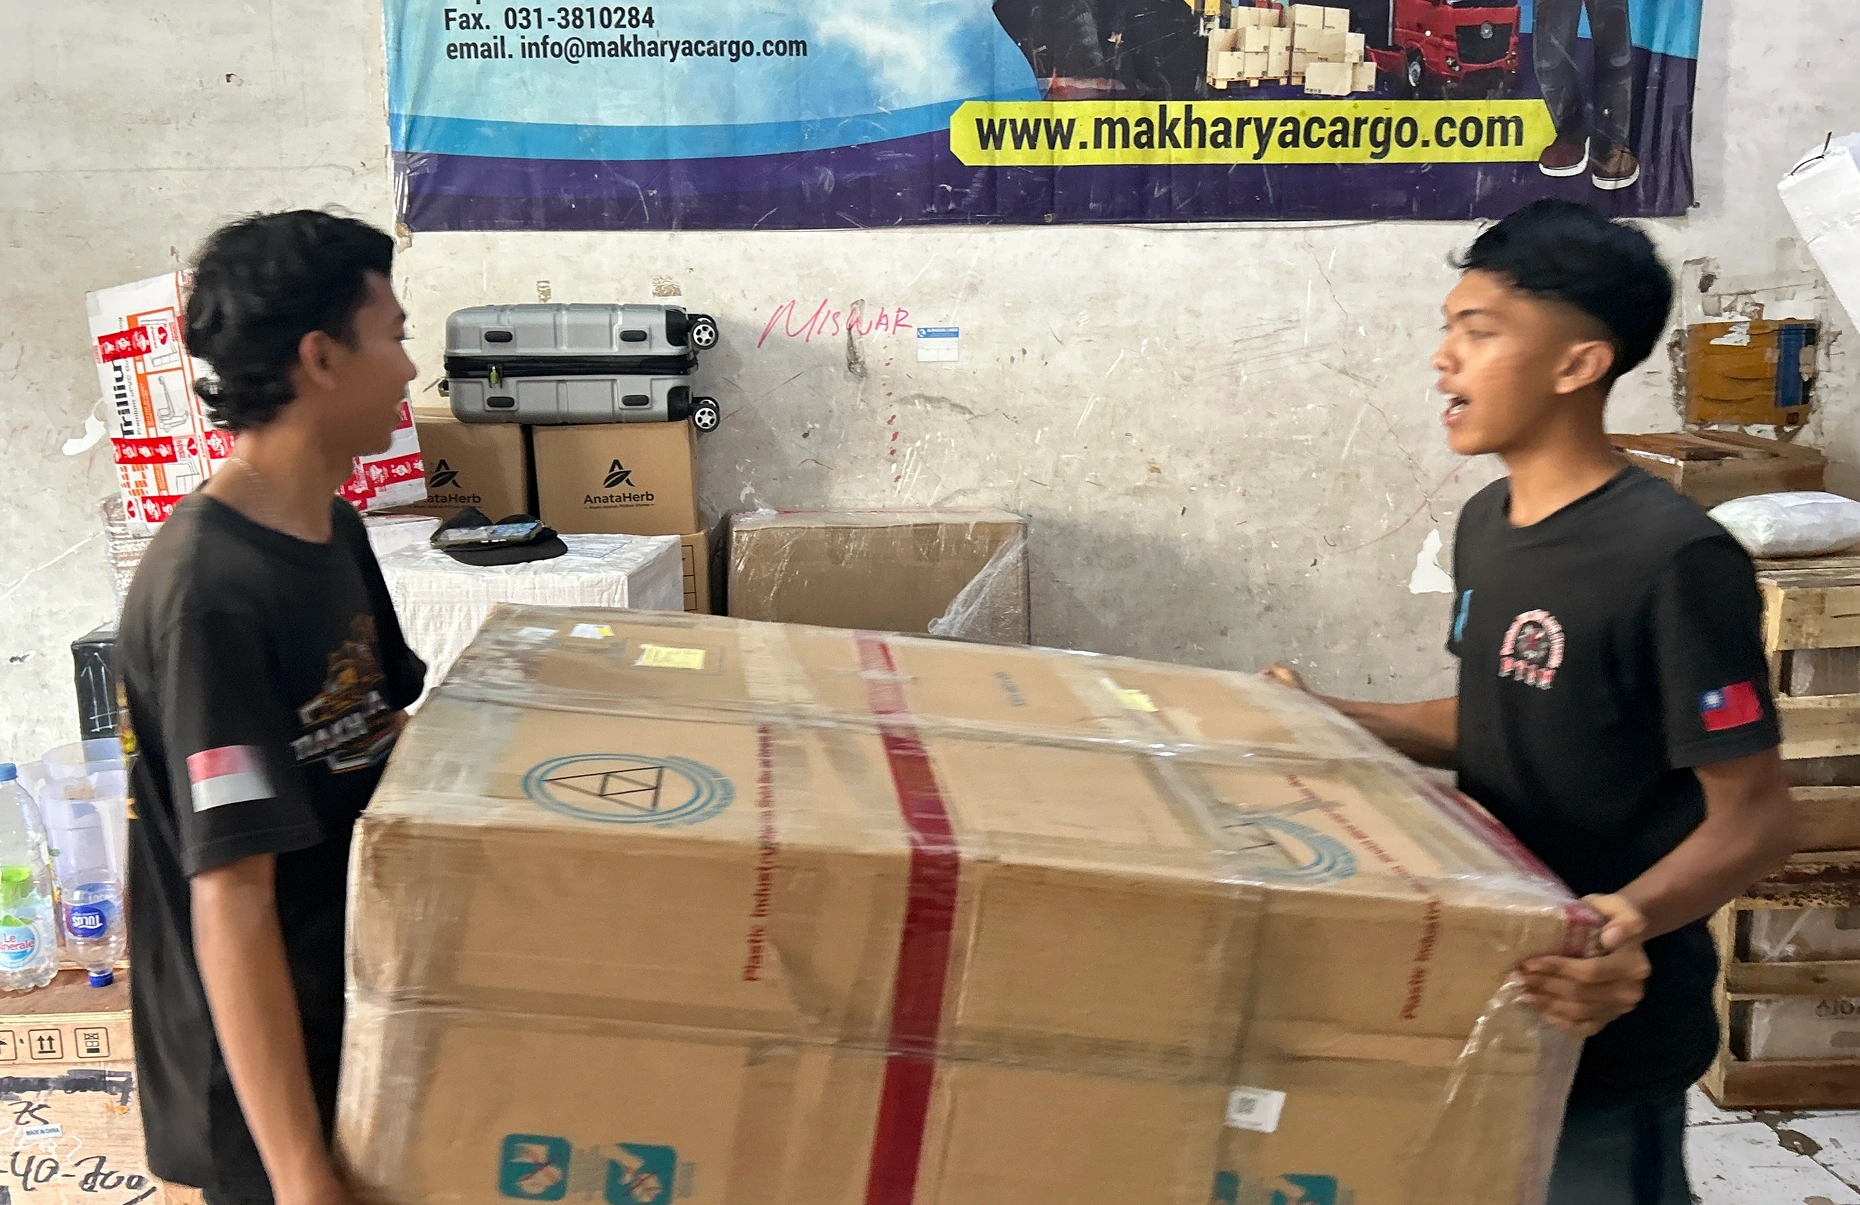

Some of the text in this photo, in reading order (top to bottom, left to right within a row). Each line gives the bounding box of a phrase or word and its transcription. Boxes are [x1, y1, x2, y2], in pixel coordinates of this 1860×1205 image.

[443, 6, 655, 31] Fax. 031-3810284
[446, 34, 808, 63] email. info@makharyacargo.com
[975, 103, 1524, 162] www.makharyacargo.com
[423, 493, 482, 504] ataHerb
[583, 490, 655, 505] AnataHerb
[3, 933, 16, 943] Le
